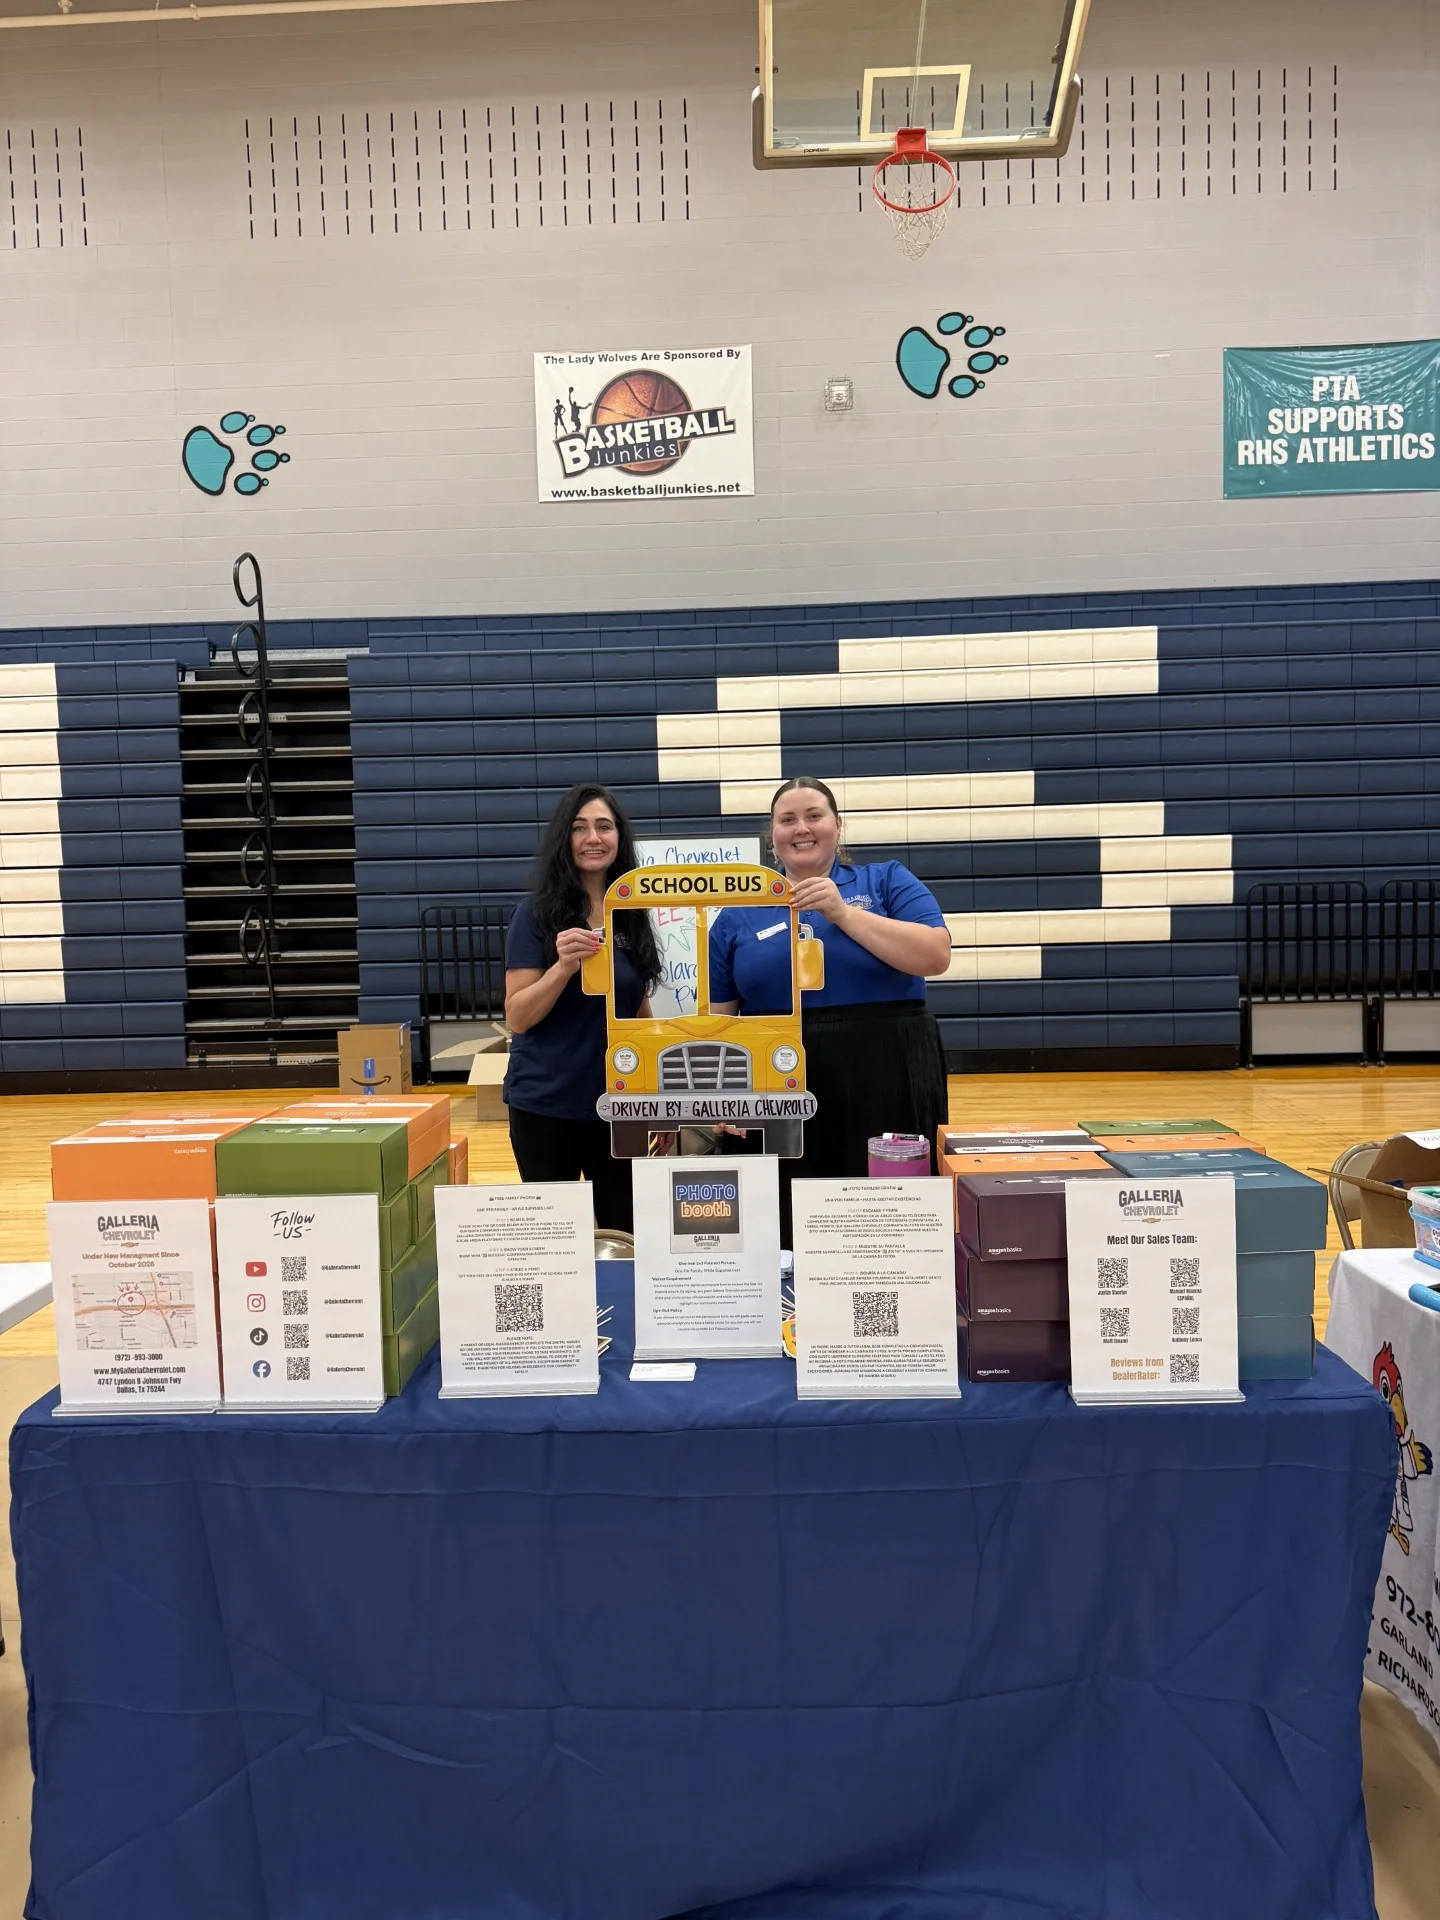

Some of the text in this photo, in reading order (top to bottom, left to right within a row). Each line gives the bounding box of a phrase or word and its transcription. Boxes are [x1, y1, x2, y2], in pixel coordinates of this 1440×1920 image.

[544, 348, 741, 365] The Lady Wolves Are Sponsored By
[1312, 375, 1361, 402] PTA
[1267, 403, 1404, 435] SUPPORTS
[556, 409, 735, 476] BASKETBALL
[1237, 432, 1436, 466] RHS ATHLETICS
[593, 442, 677, 466] Junkies
[551, 482, 741, 498] www.basketballjunkies.net
[640, 876, 762, 894] SCHOOL BUS
[612, 1101, 659, 1117] DRIVEN
[692, 1100, 750, 1118] GALLERIA
[755, 1098, 816, 1116] CHEVROLET
[676, 1184, 736, 1200] PHOTO
[1118, 1189, 1184, 1208] GALLERIA
[680, 1201, 732, 1218] booth
[1123, 1206, 1180, 1216] CHEVROLET
[97, 1214, 160, 1232] GALLERIA
[270, 1210, 315, 1228] Follow
[102, 1230, 156, 1241] CHEVROLET
[694, 1235, 720, 1243] GALLERIA
[1107, 1234, 1198, 1245] Meet Our Sales Team:
[82, 1252, 103, 1260] Under
[988, 1246, 1022, 1255] amazonbasics
[1111, 1358, 1164, 1368] Reviews from
[977, 1368, 1010, 1376] amazonbasics
[1112, 1371, 1160, 1381] DealerRater:
[114, 1378, 136, 1386] Lyndon
[1380, 1617, 1434, 1680] GARLAND
